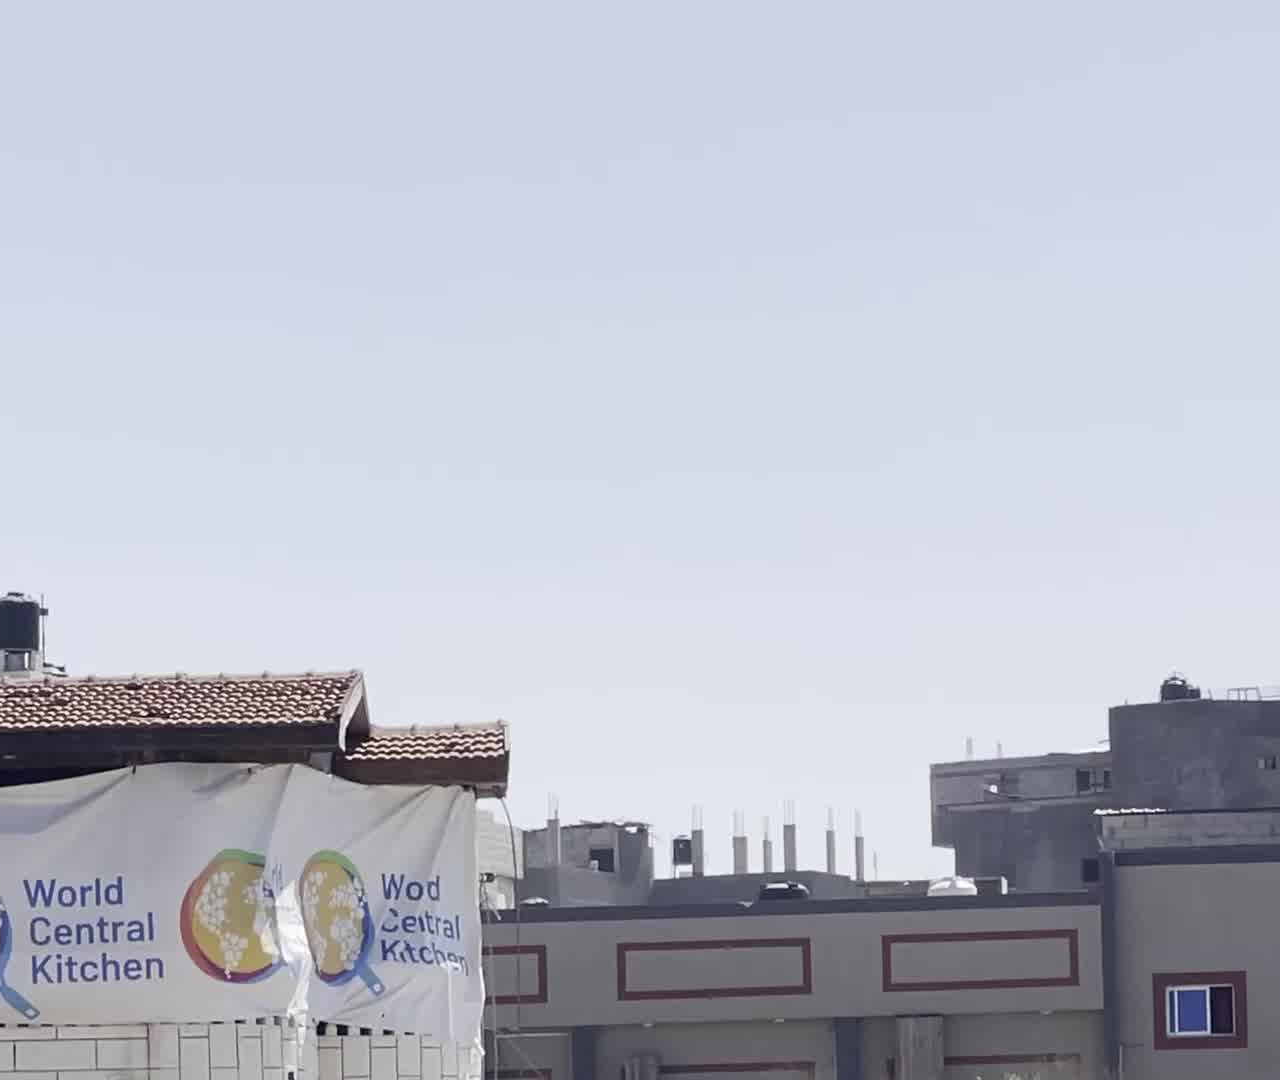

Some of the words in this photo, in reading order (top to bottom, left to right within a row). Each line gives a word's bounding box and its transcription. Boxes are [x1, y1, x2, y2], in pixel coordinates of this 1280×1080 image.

[22, 875, 124, 909] World
[29, 911, 155, 946] Central
[31, 952, 164, 985] Kitchen
